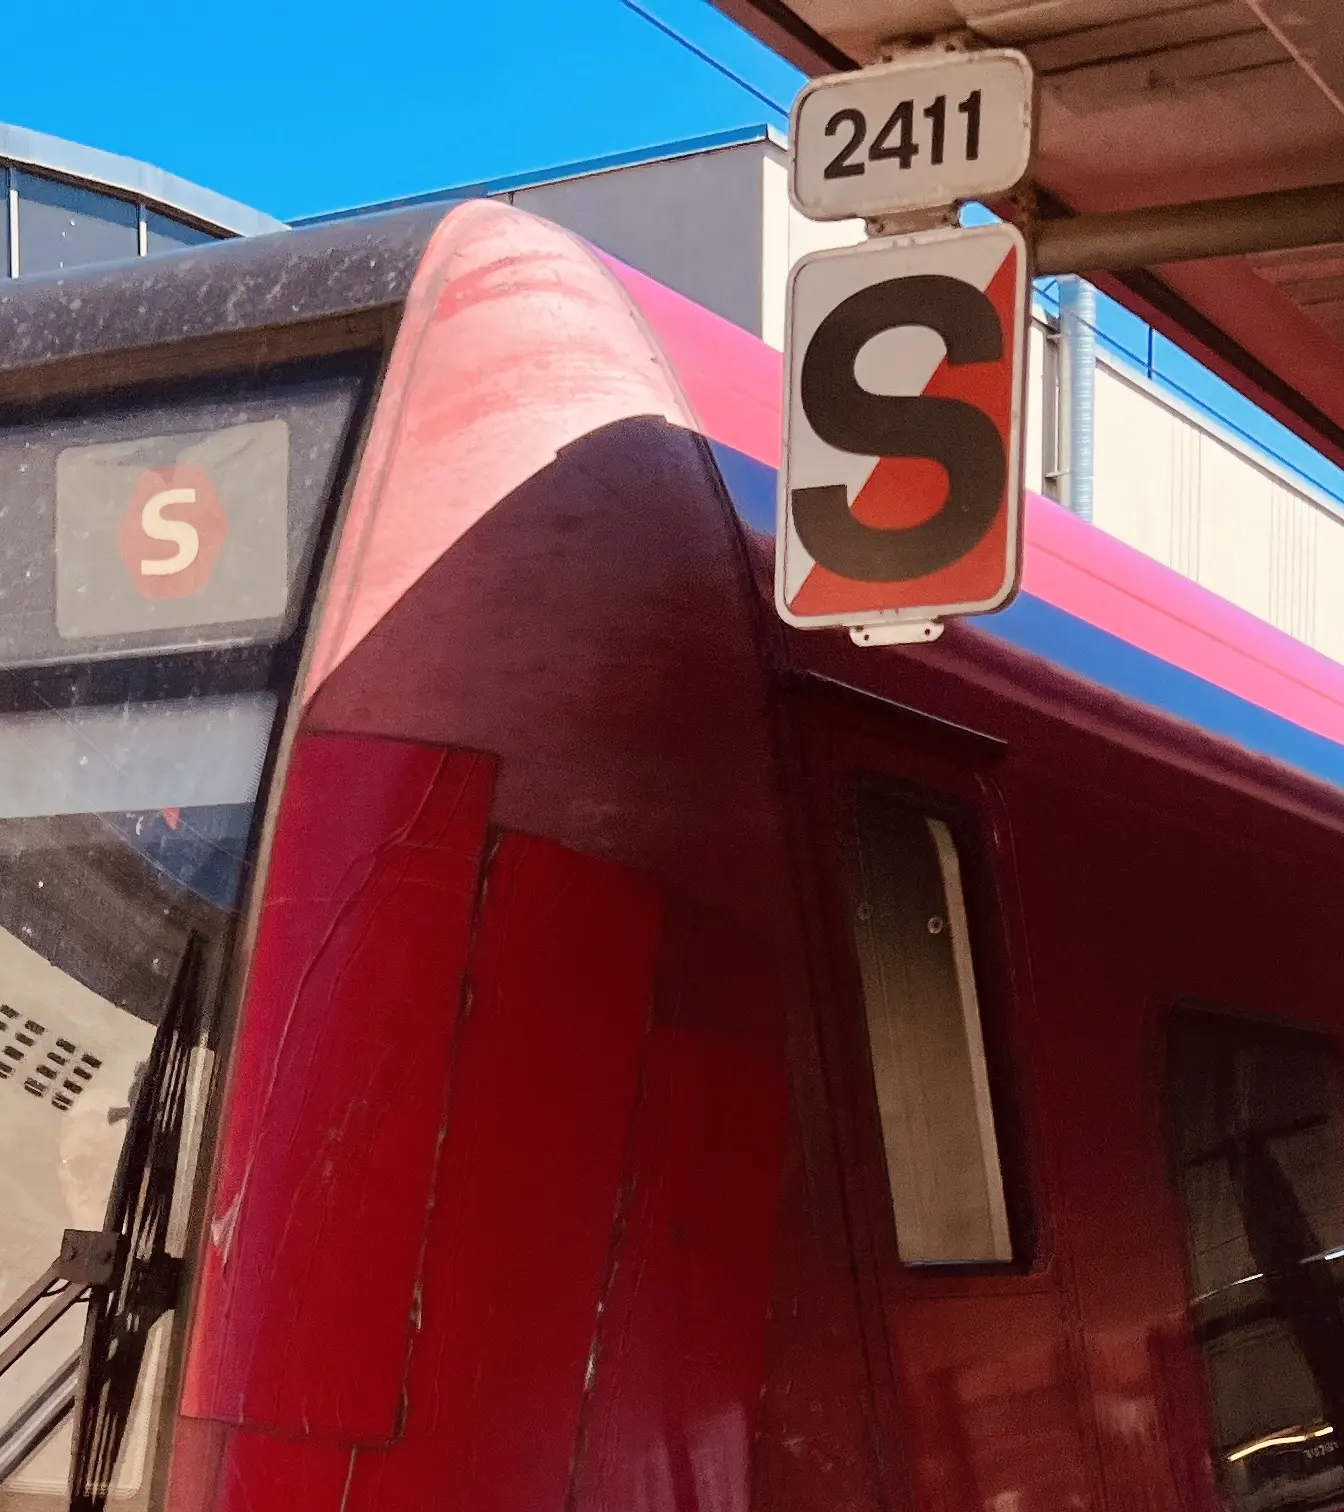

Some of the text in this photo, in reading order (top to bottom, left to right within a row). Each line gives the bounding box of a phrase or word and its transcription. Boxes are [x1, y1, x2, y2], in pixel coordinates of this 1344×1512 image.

[823, 89, 982, 180] 2411
[791, 273, 1006, 583] S
[141, 488, 200, 576] S
